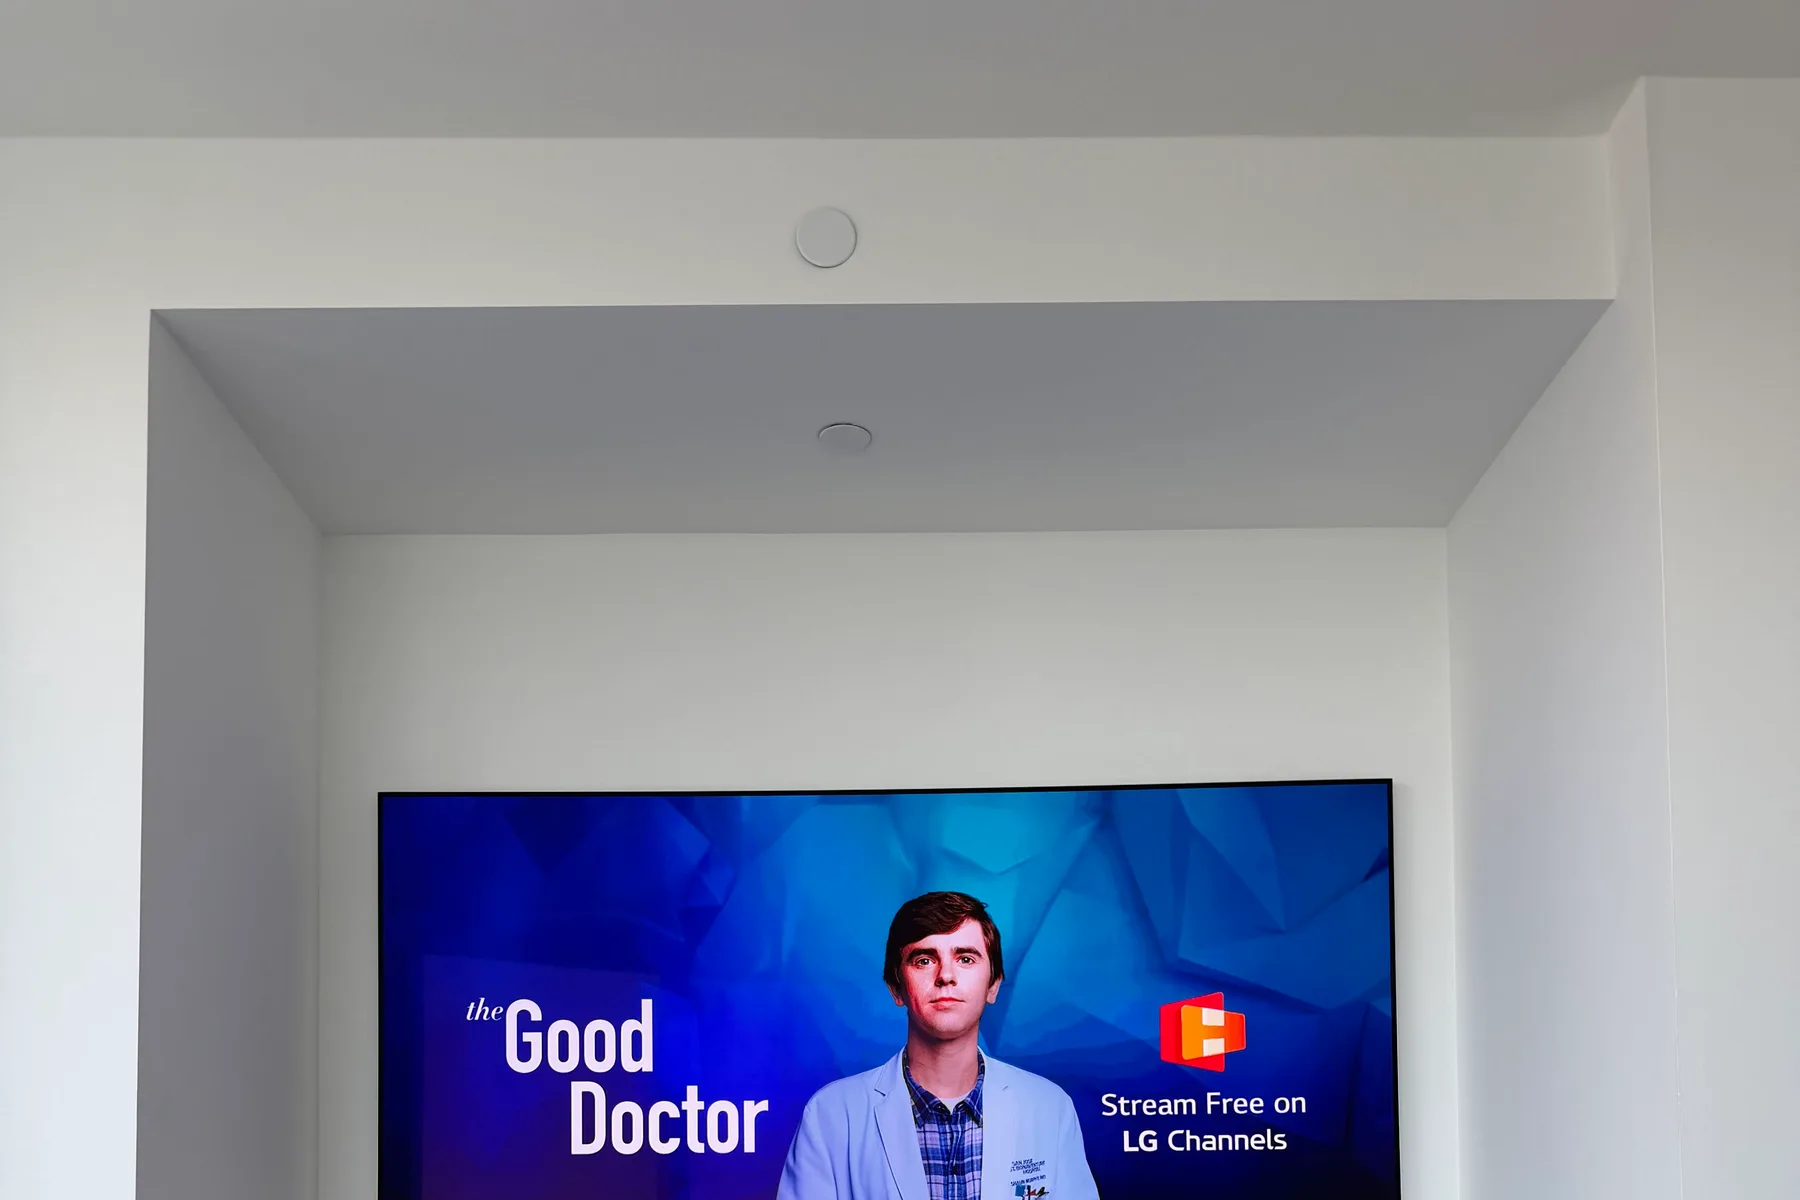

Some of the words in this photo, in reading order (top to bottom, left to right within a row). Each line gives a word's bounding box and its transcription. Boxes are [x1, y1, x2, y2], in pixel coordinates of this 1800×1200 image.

[466, 997, 503, 1021] the
[505, 998, 654, 1074] Good
[571, 1080, 769, 1155] Doctor
[1101, 1093, 1197, 1116] Stream
[1206, 1092, 1264, 1115] Free
[1274, 1095, 1307, 1114] on
[1123, 1130, 1158, 1152] LG
[1167, 1128, 1288, 1151] Channels
